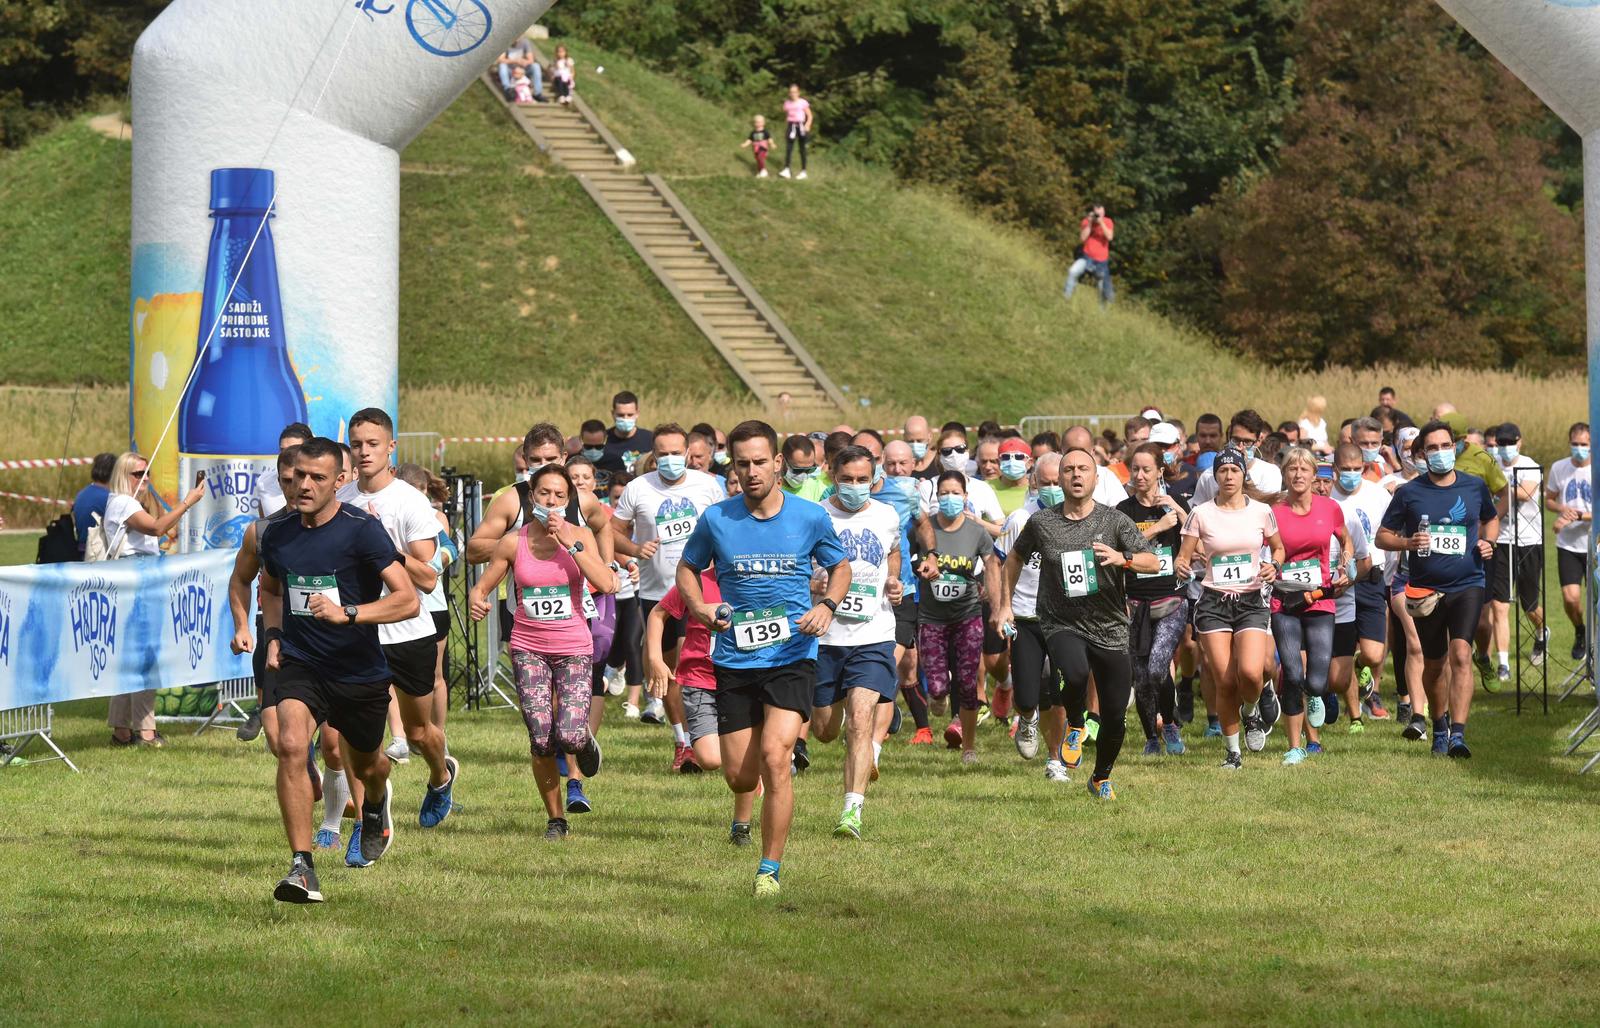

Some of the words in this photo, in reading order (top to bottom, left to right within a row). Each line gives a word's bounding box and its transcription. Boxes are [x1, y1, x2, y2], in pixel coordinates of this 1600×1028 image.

[228, 300, 262, 313] SADRŽI
[221, 315, 269, 326] PRIRODNE
[219, 327, 271, 338] SASTOJKE
[664, 521, 692, 537] 199
[1434, 537, 1460, 550] 188
[1159, 559, 1168, 571] 2
[1067, 564, 1083, 585] 58
[1223, 566, 1241, 580] 41
[1293, 571, 1311, 583] 33
[934, 584, 960, 598] 105
[300, 591, 323, 609] 7
[531, 599, 564, 616] 192
[841, 596, 863, 612] 55
[744, 622, 781, 644] 139
[188, 635, 204, 670] ISO
[90, 643, 107, 680] ISO
